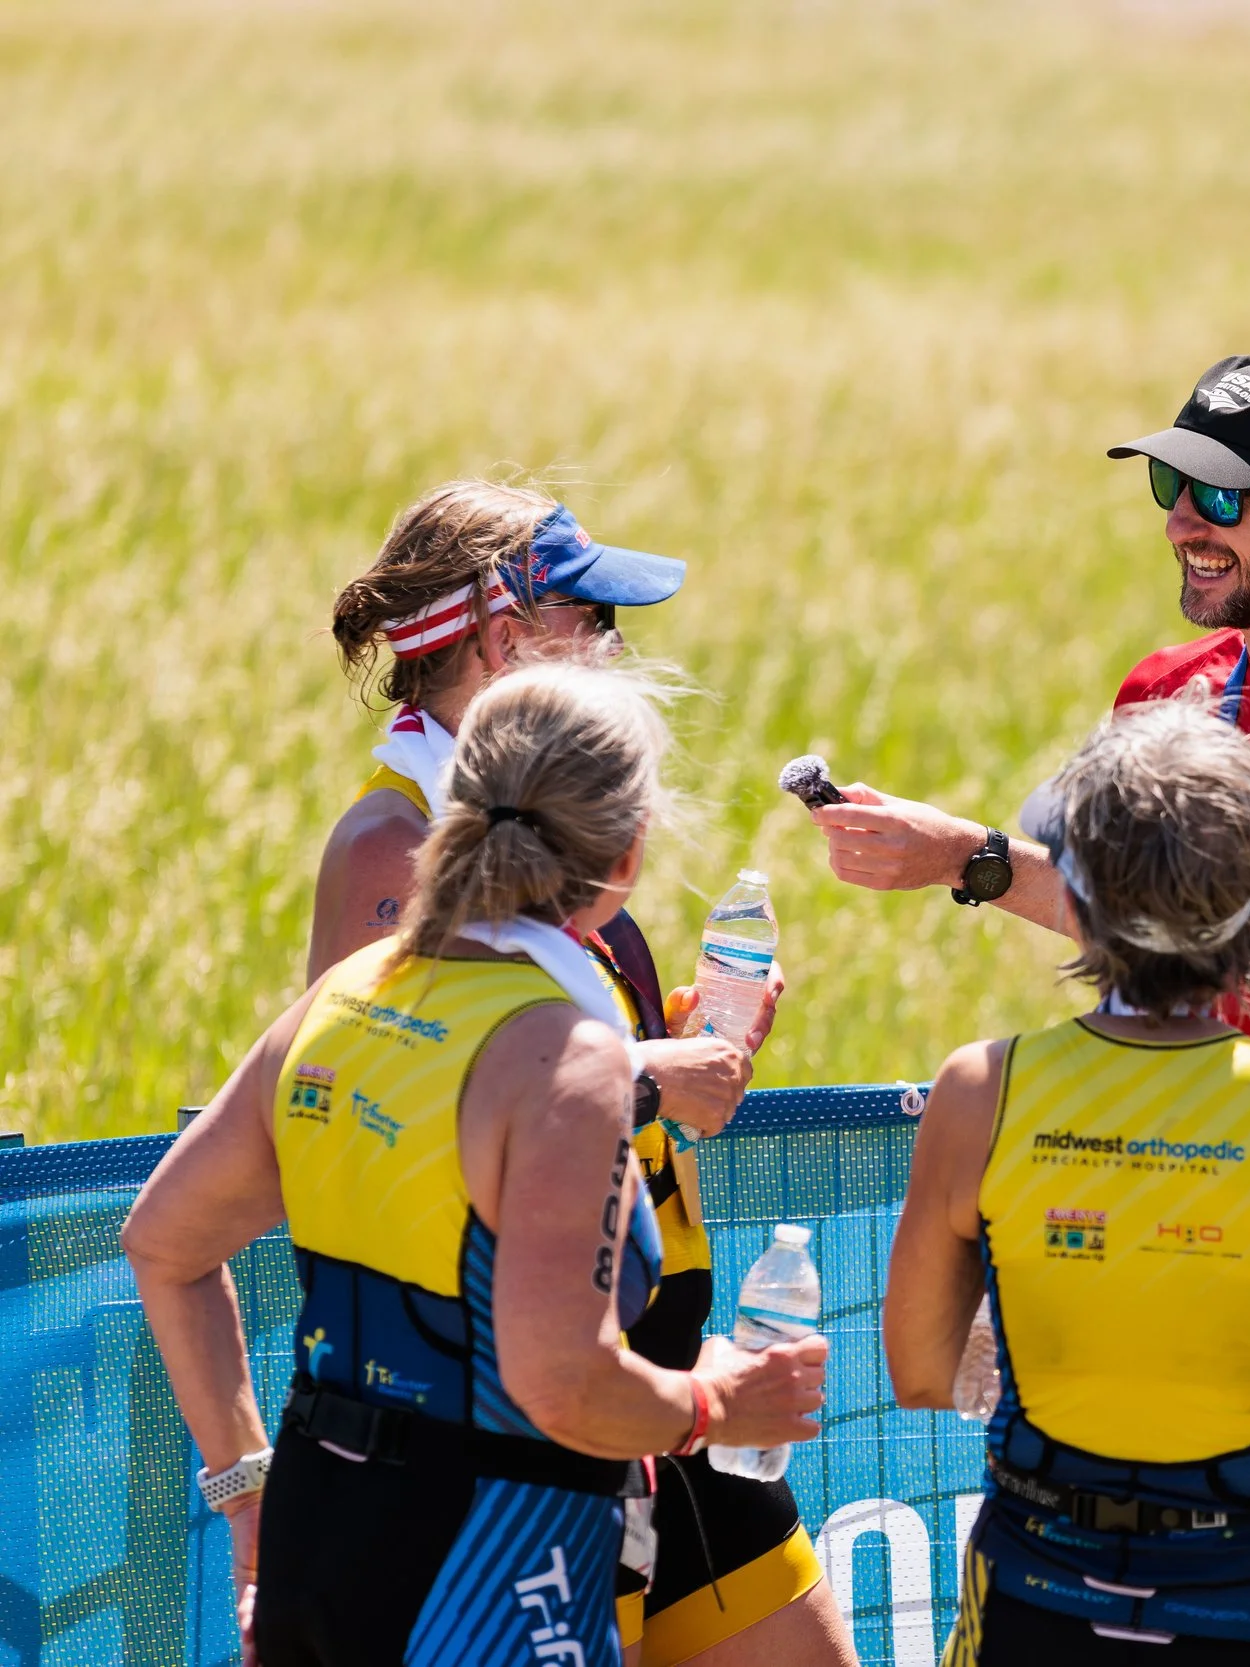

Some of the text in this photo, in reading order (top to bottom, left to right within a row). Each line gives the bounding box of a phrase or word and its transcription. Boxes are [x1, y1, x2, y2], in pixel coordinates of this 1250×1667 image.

[369, 1005, 449, 1042] orthopedic
[1033, 1129, 1245, 1163] midwest orthopedic
[1031, 1154, 1219, 1176] SPECIALTY HOSPITAL
